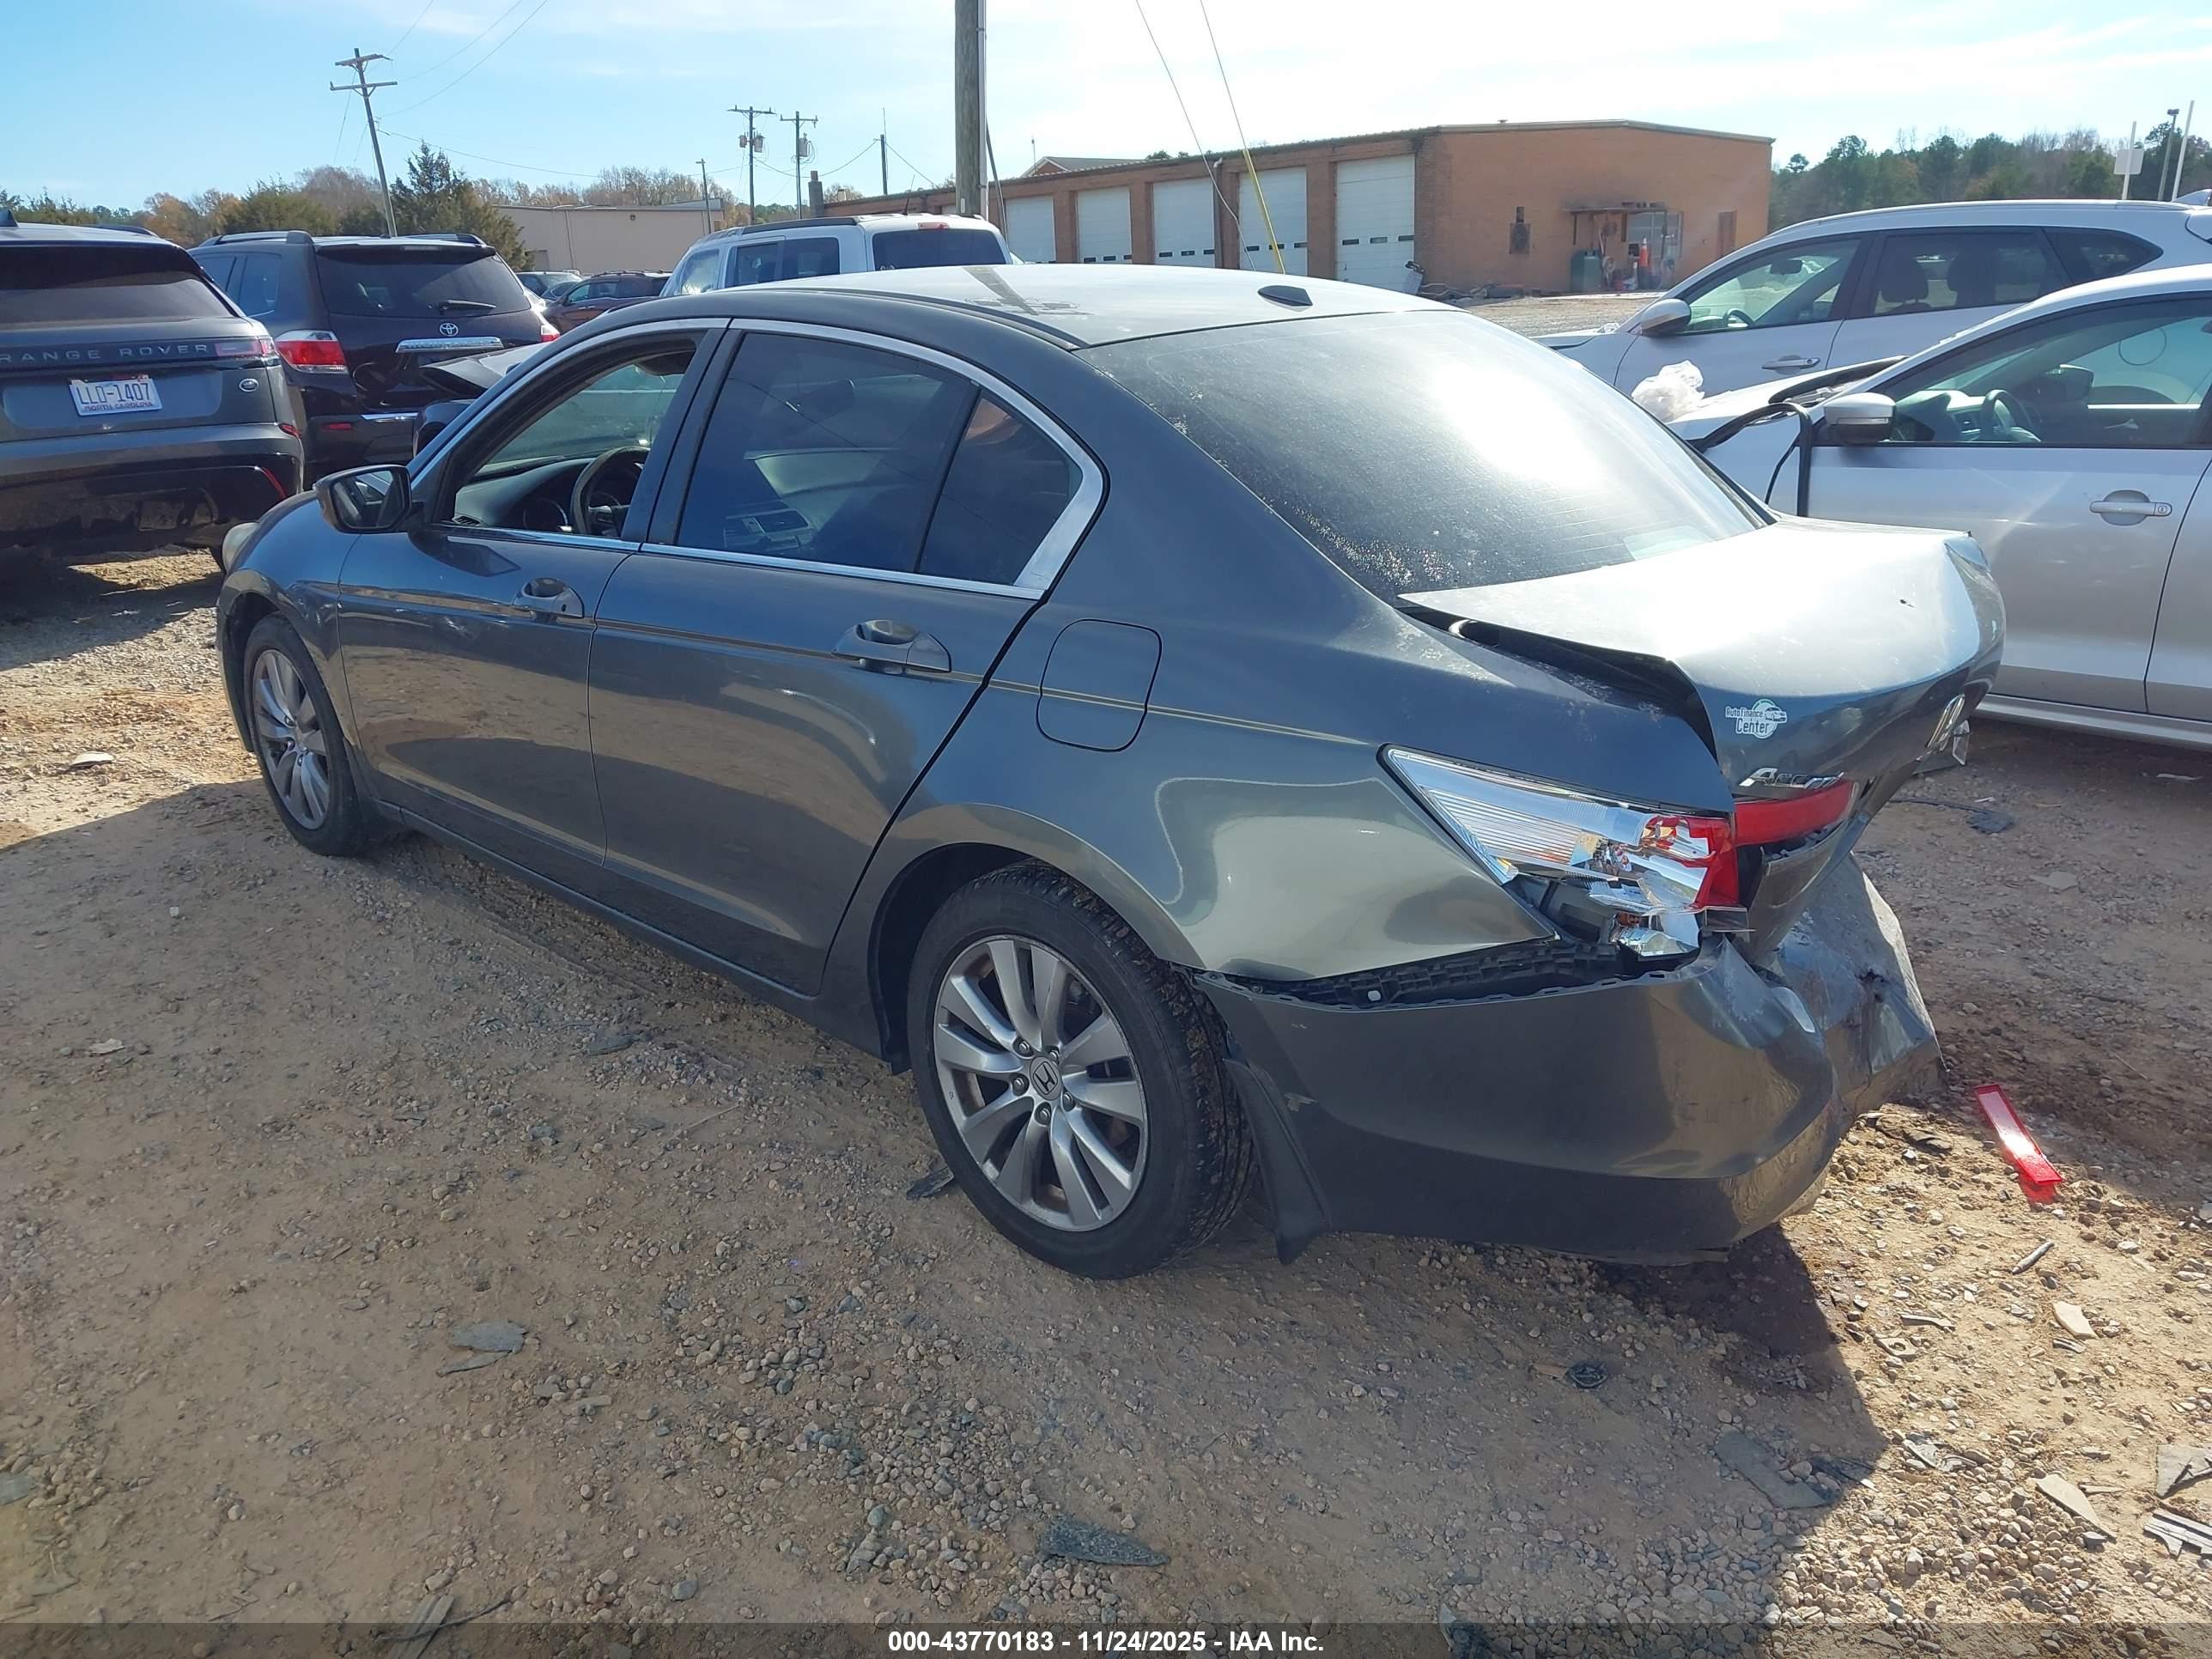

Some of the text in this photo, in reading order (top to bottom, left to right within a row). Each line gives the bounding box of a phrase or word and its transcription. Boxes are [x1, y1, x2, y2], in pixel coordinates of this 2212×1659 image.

[0, 344, 207, 362] RANGE ROVER
[114, 401, 152, 410] CAROLINA
[1736, 718, 1770, 733] Center
